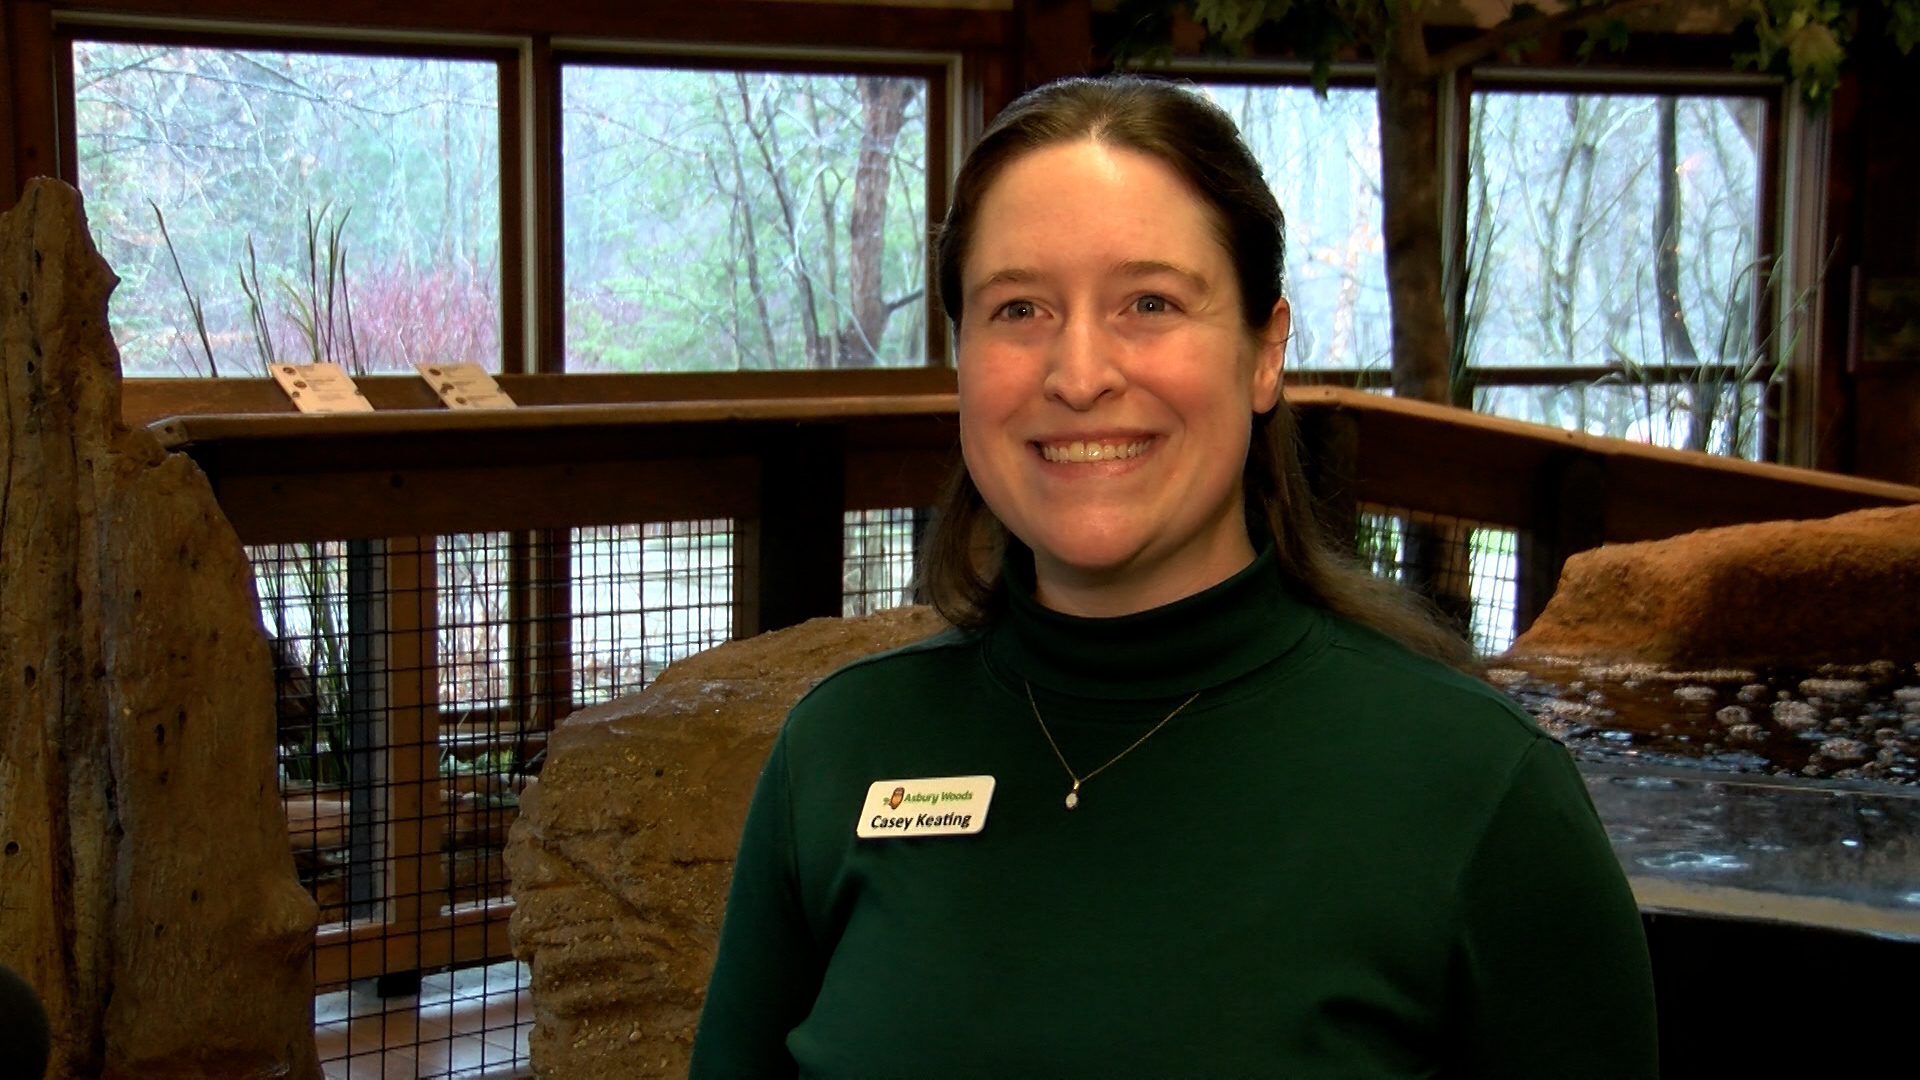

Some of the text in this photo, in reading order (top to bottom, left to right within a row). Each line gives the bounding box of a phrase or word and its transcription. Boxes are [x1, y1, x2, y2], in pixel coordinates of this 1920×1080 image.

[904, 790, 973, 804] Asbury Woods
[871, 812, 972, 831] Casey Keating
